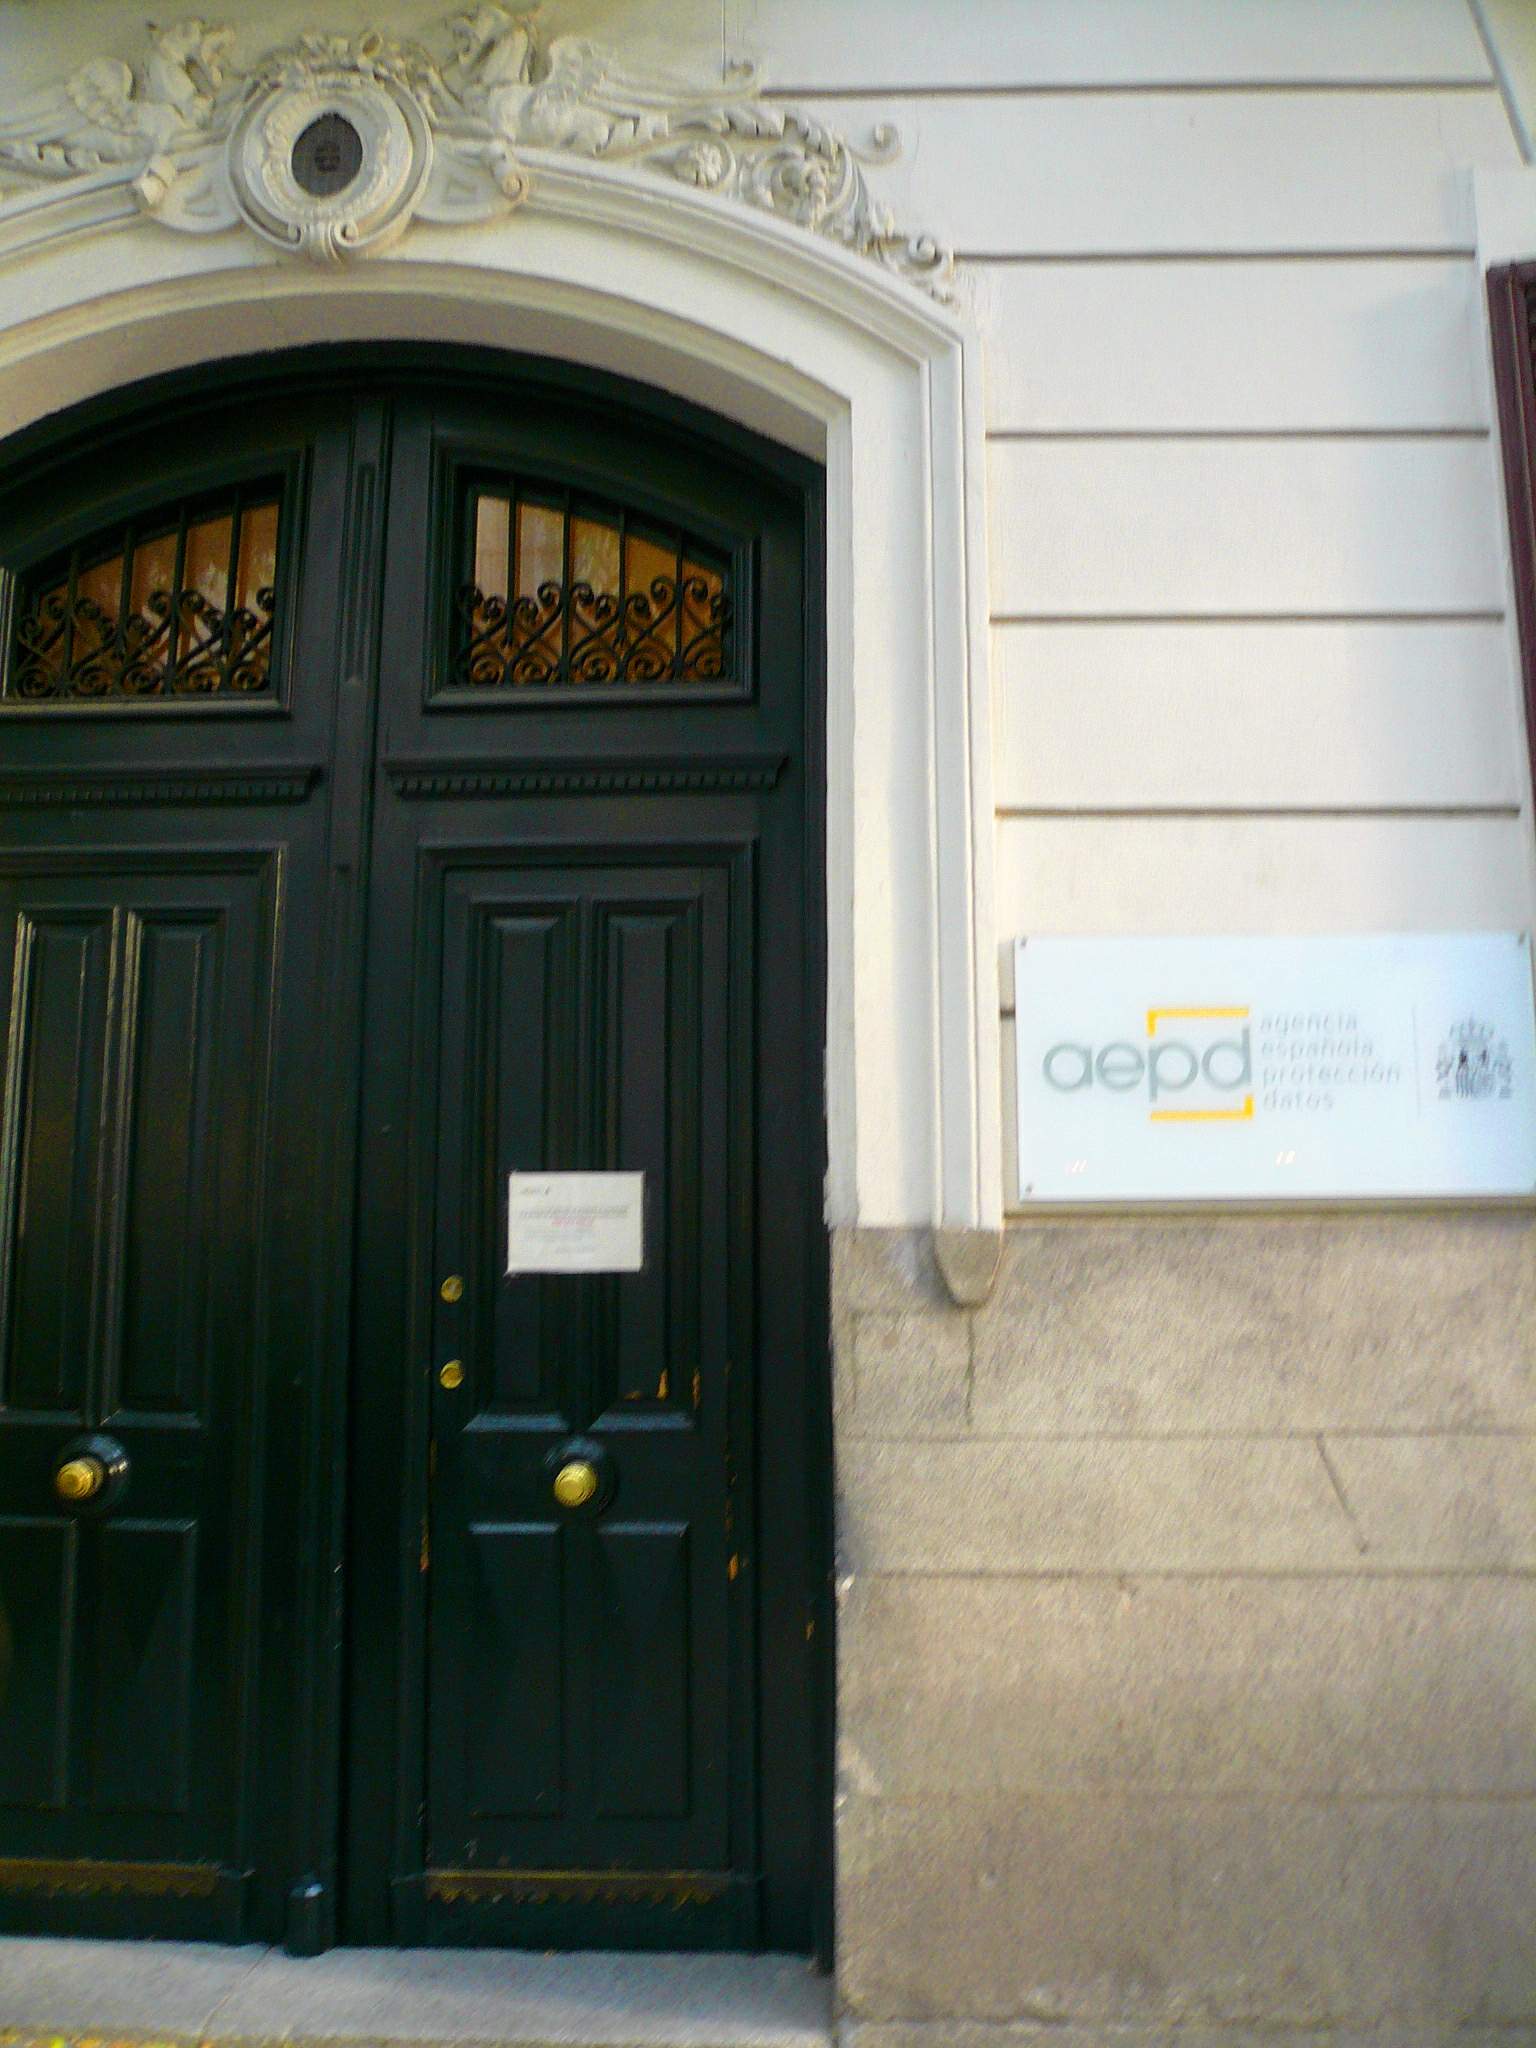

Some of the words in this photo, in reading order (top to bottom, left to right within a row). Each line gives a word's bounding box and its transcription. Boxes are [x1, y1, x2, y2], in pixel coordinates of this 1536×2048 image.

[1260, 1012, 1358, 1037] agencia
[1042, 1025, 1252, 1102] aepd
[1263, 1089, 1335, 1111] datos
